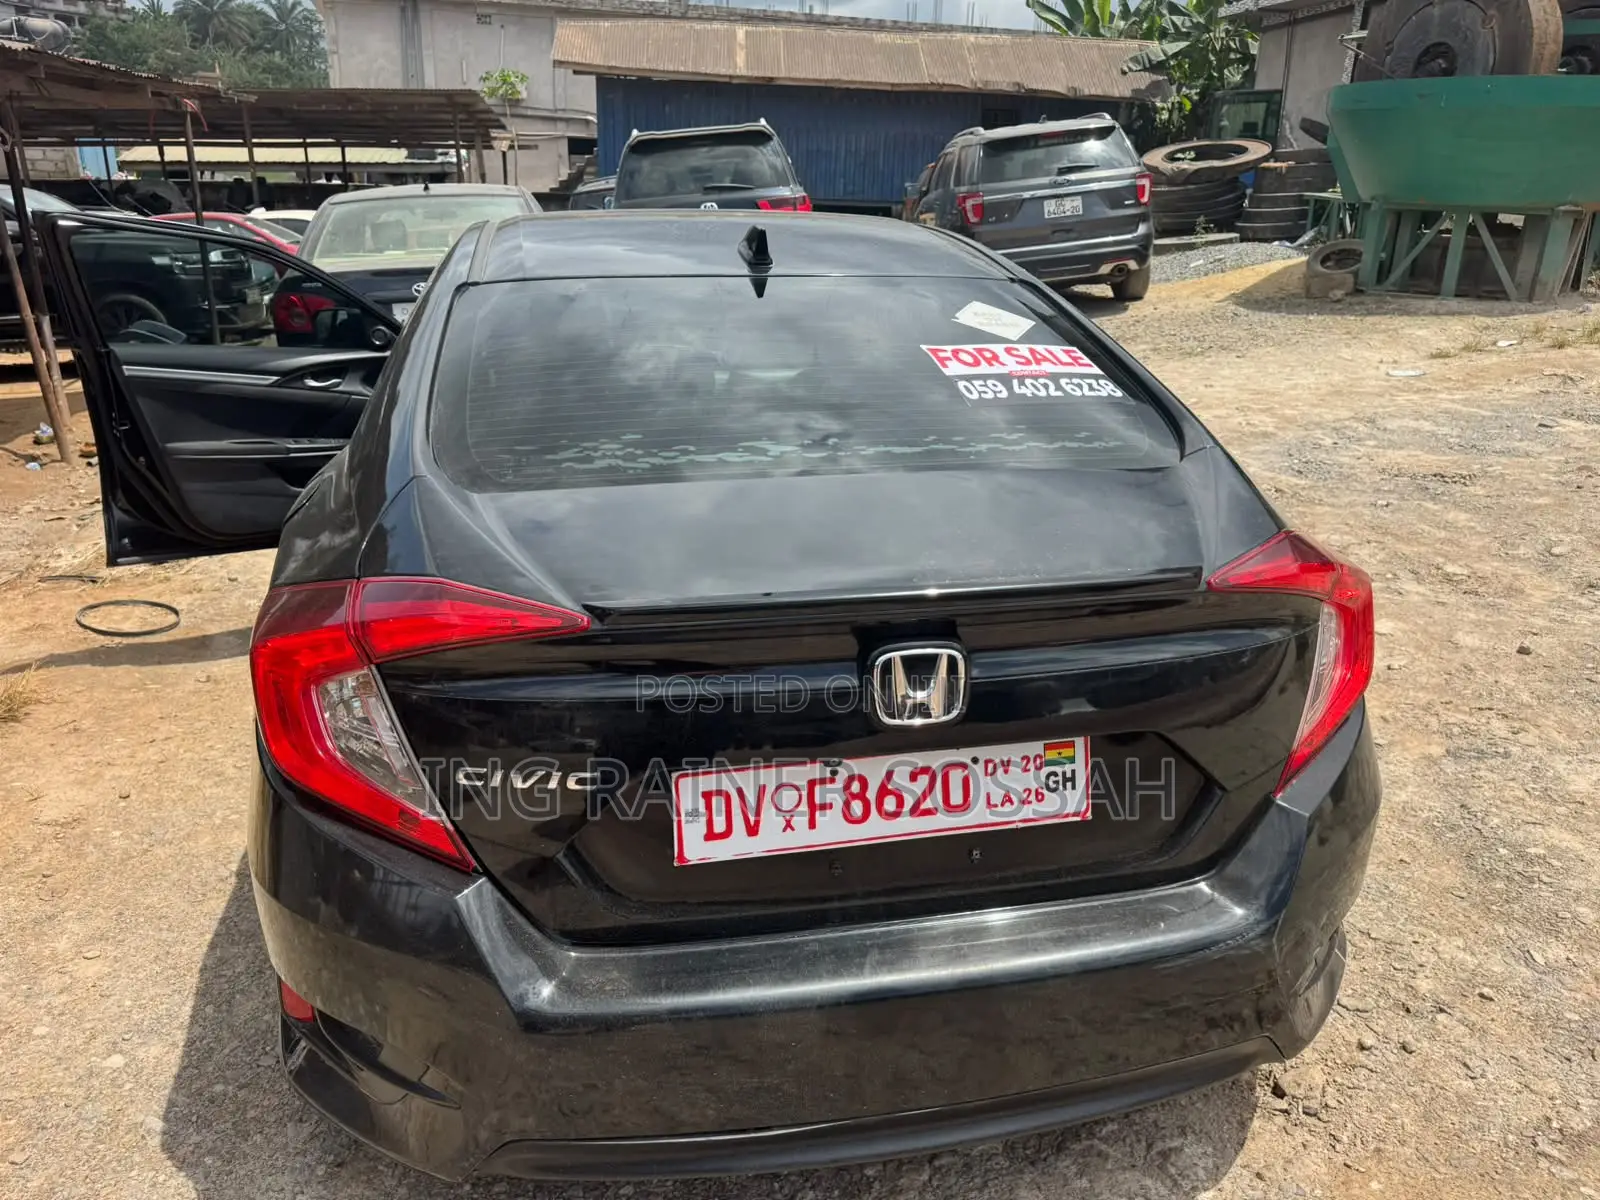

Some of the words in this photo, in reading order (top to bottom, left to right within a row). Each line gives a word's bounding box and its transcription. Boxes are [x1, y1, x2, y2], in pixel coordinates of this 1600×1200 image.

[927, 347, 1005, 368] FOR
[1007, 346, 1093, 368] SALE
[957, 378, 1008, 400] 059
[1012, 378, 1063, 397] 402
[1061, 378, 1124, 398] 6238
[983, 757, 1012, 777] DV
[1021, 753, 1045, 772] 20
[455, 767, 600, 790] CIVIC
[1044, 768, 1077, 793] GH
[701, 784, 767, 842] DV
[806, 762, 972, 830] F8620
[985, 790, 1016, 810] LA
[1022, 786, 1045, 804] 26
